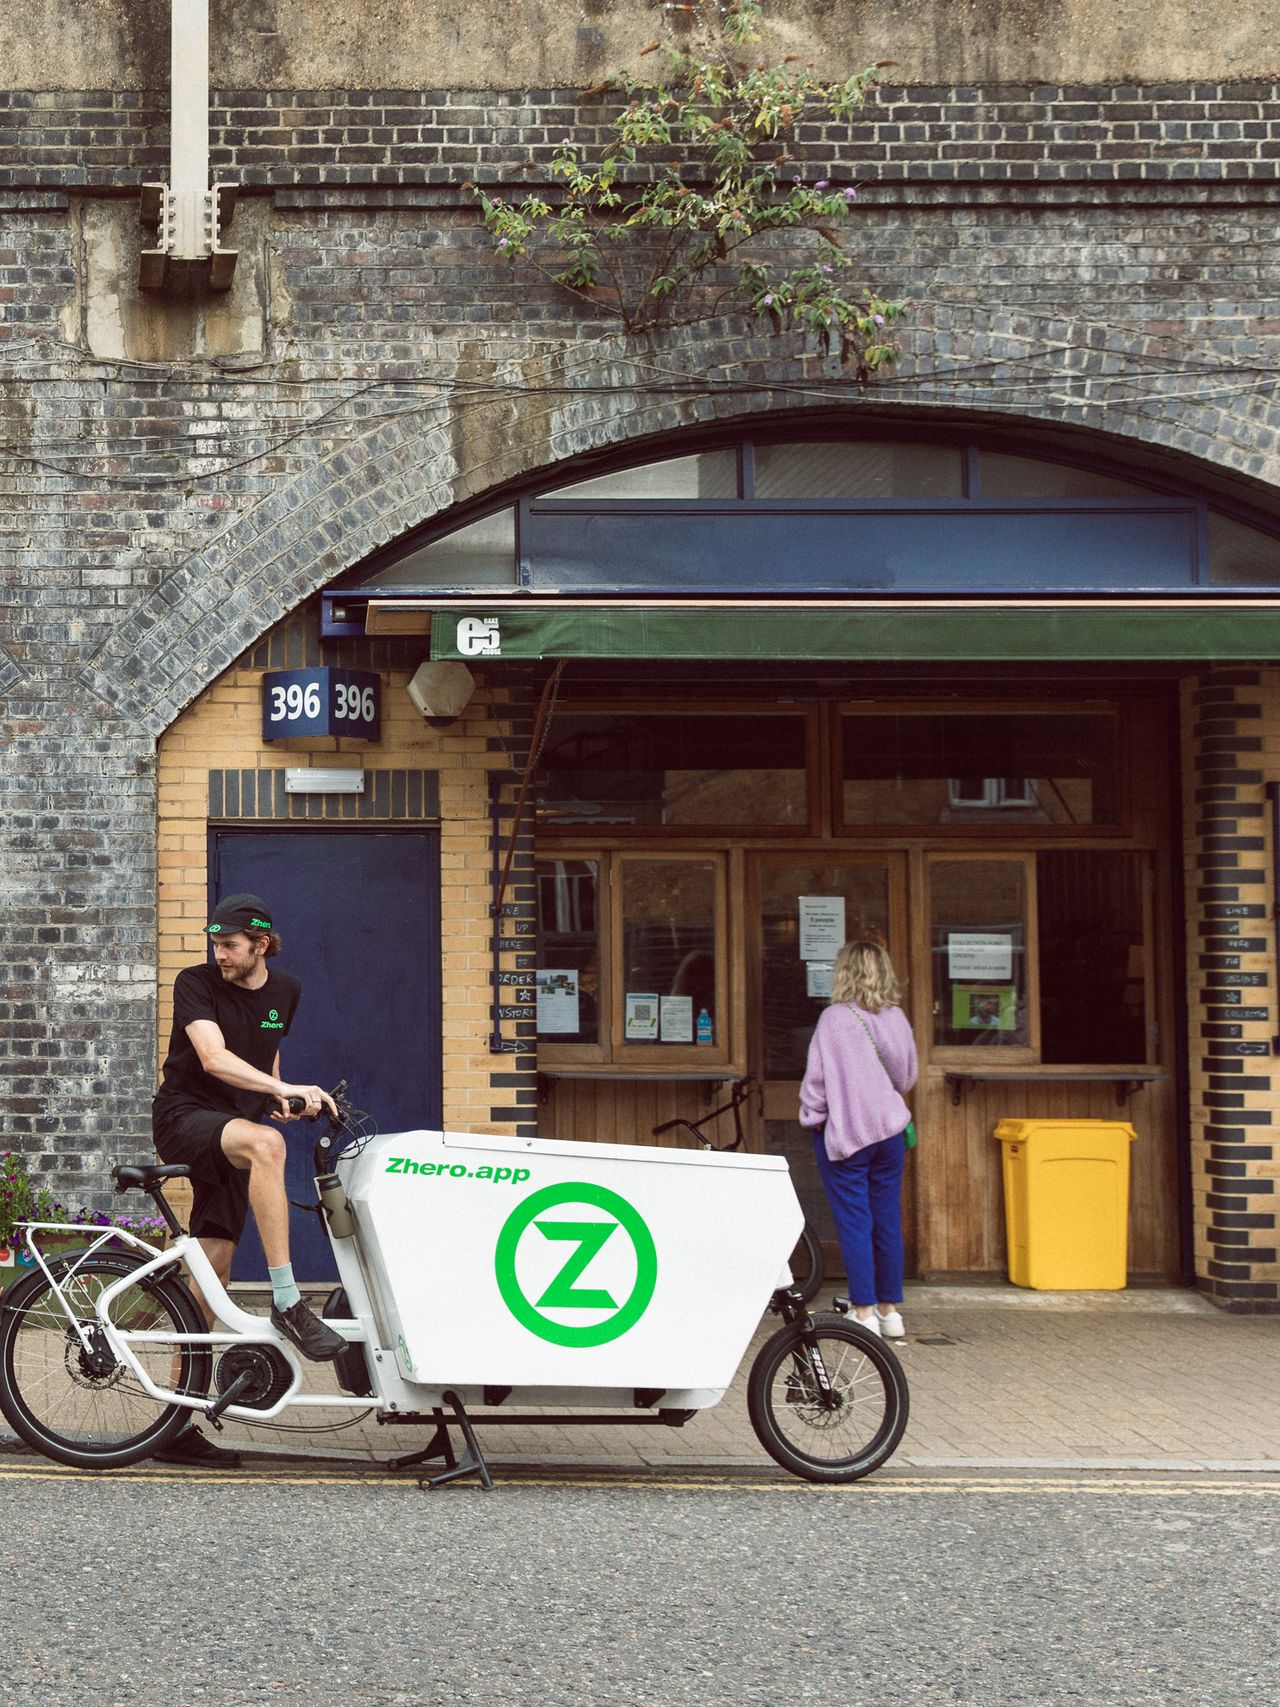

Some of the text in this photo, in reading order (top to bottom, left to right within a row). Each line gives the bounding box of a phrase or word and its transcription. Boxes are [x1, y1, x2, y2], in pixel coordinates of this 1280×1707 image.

[270, 682, 321, 721] 396
[334, 683, 375, 722] 396
[516, 923, 529, 933] UP
[499, 940, 524, 950] HERE
[517, 958, 528, 967] TO
[260, 1021, 284, 1029] Zhero
[384, 1156, 532, 1185] Zhero.app
